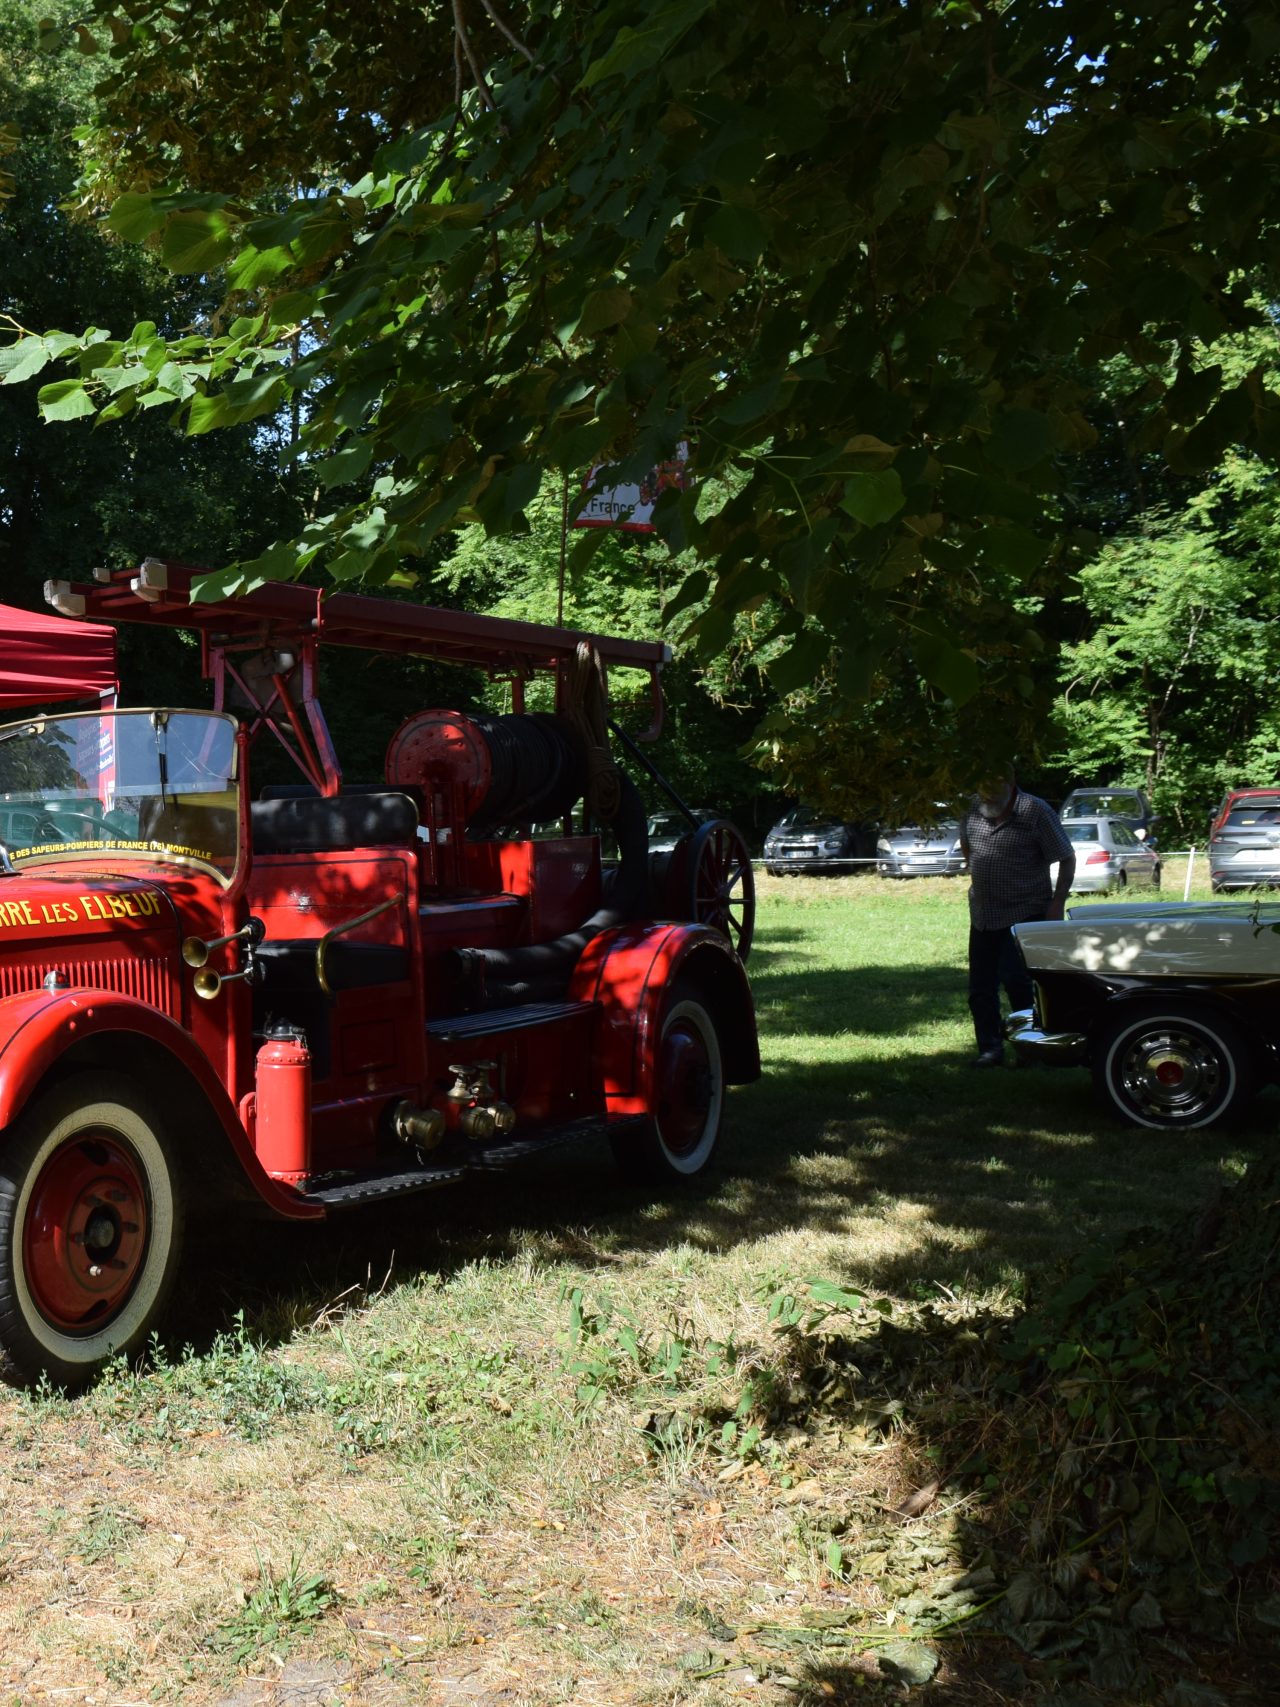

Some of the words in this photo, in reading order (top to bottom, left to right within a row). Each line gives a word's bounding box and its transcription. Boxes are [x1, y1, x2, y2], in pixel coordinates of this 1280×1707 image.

[590, 497, 636, 514] France
[15, 847, 31, 859] DES
[31, 840, 104, 855] SAPEURS-POMPIERS
[105, 840, 117, 850] DE
[117, 840, 148, 850] FRANCE
[149, 840, 165, 853] (76)
[166, 844, 212, 861] MONTVILLE
[41, 903, 78, 924] LES
[79, 891, 161, 920] ELBEUF
